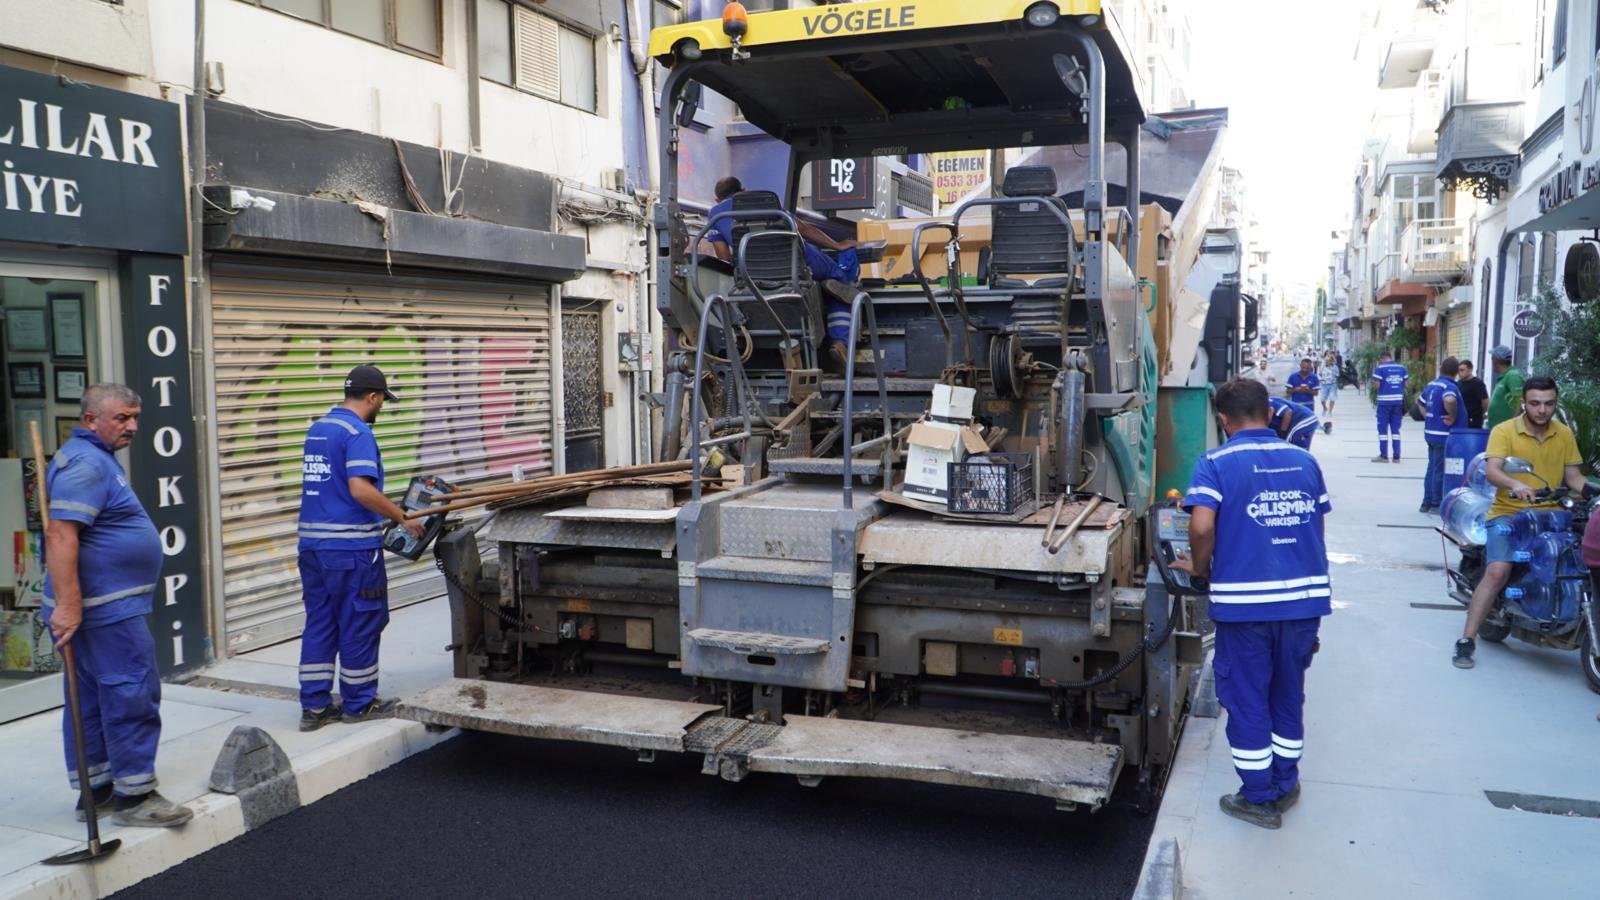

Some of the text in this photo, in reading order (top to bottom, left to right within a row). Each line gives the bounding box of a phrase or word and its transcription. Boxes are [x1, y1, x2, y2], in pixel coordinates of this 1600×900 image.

[802, 5, 916, 36] VÖGELE
[937, 156, 985, 173] EGEMEN
[936, 175, 963, 188] 0533
[1260, 490, 1279, 502] BİZE
